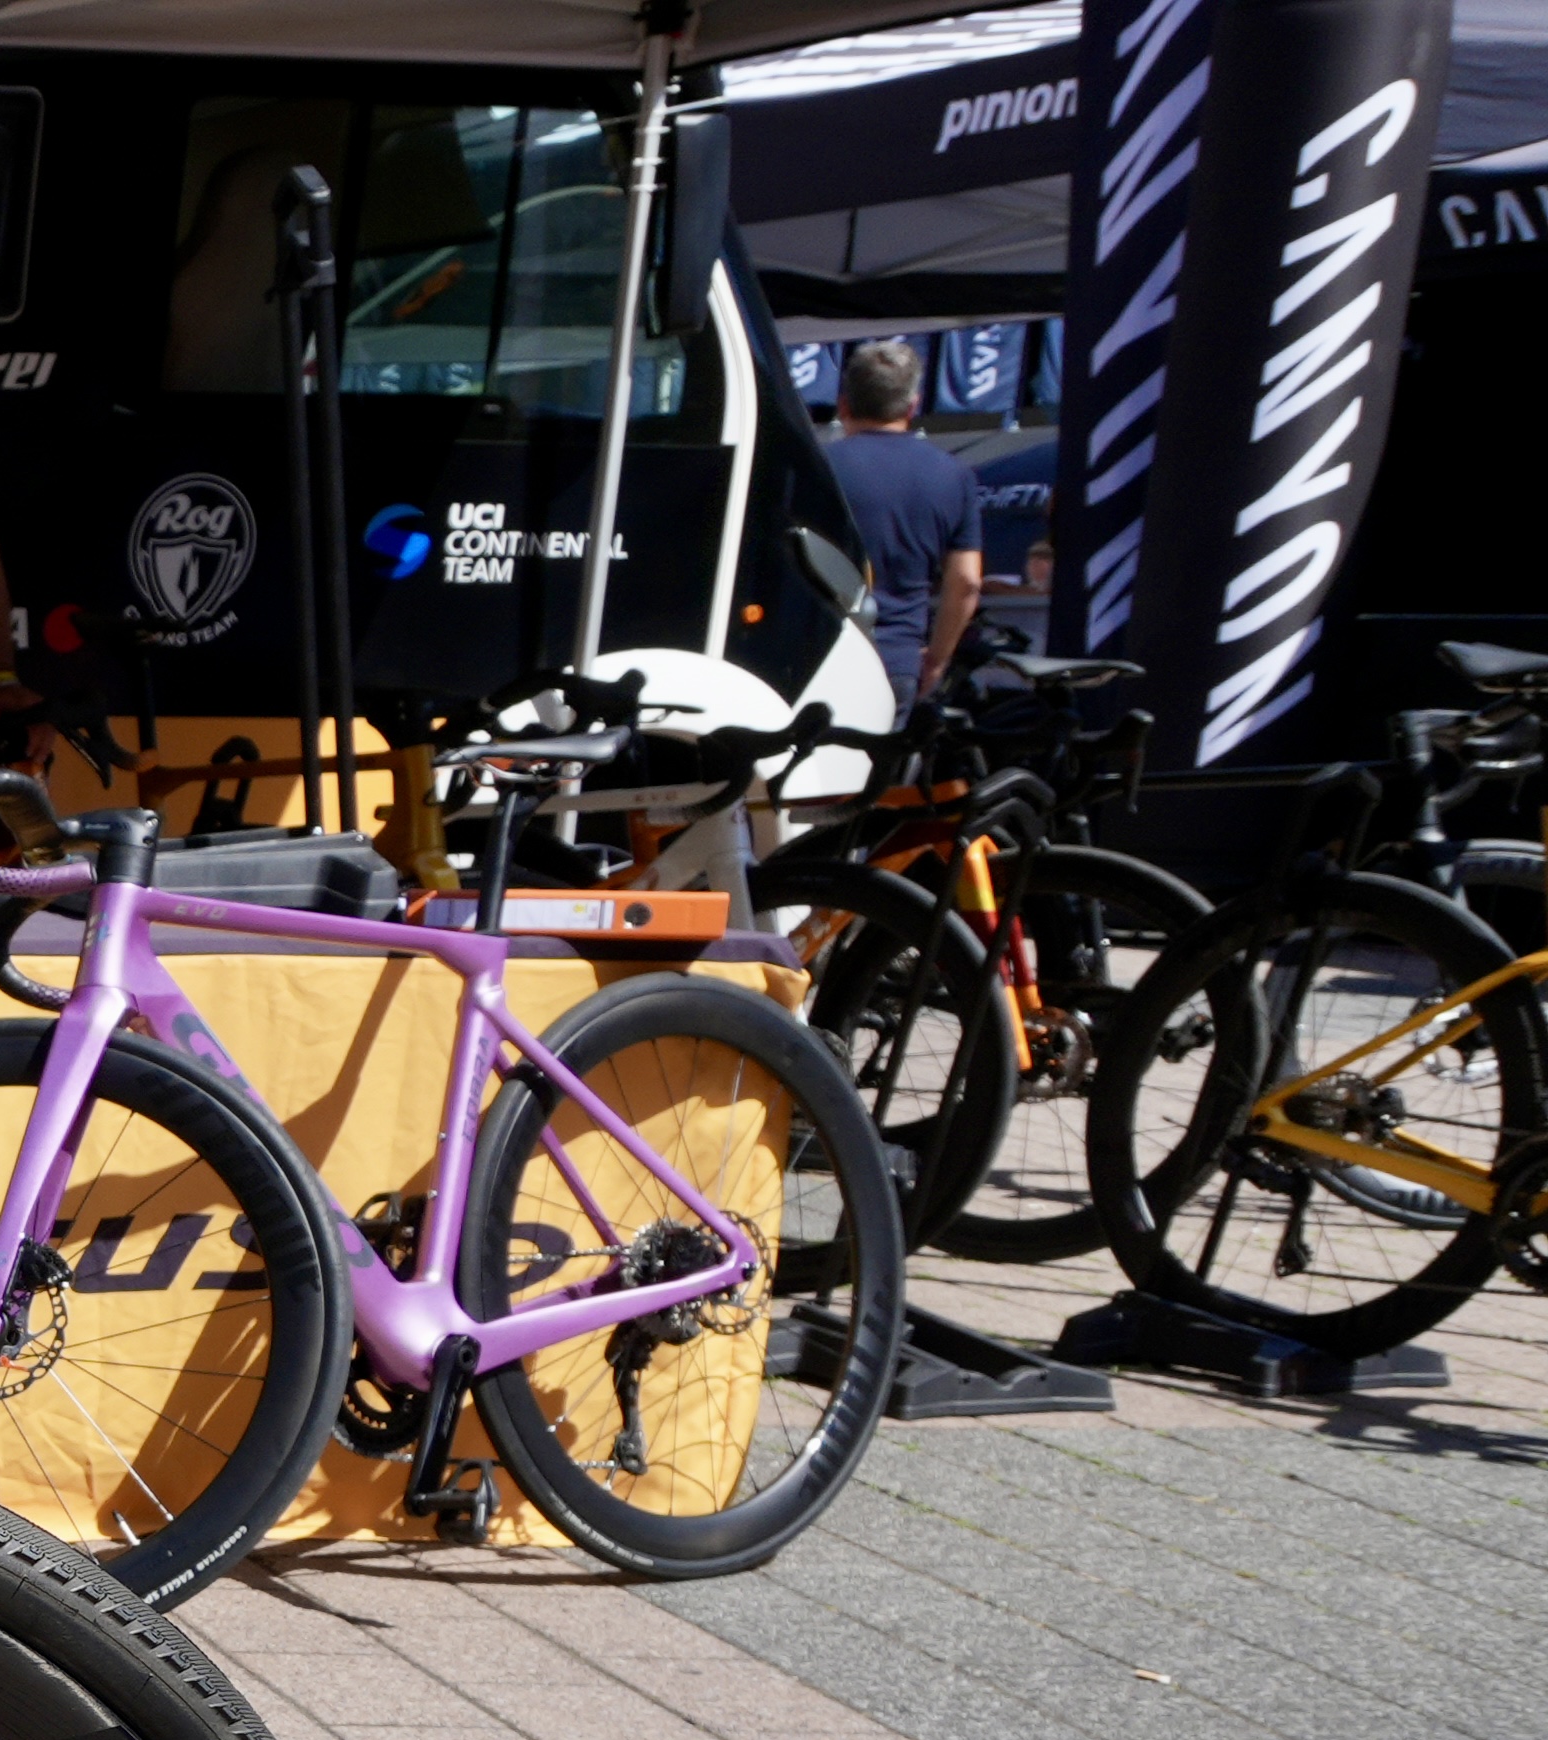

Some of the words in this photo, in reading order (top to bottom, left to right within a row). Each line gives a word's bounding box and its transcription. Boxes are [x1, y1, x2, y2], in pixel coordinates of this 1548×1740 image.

[933, 78, 1079, 154] pinion
[1439, 185, 1548, 249] CA
[1086, 0, 1213, 653] ANYON
[154, 493, 234, 539] Rog
[446, 502, 506, 530] UCI
[443, 530, 629, 560] CONTINENL
[443, 557, 515, 583] TEAM
[194, 1520, 249, 1575] GOODYEAR
[157, 1562, 196, 1601] EAGLE
